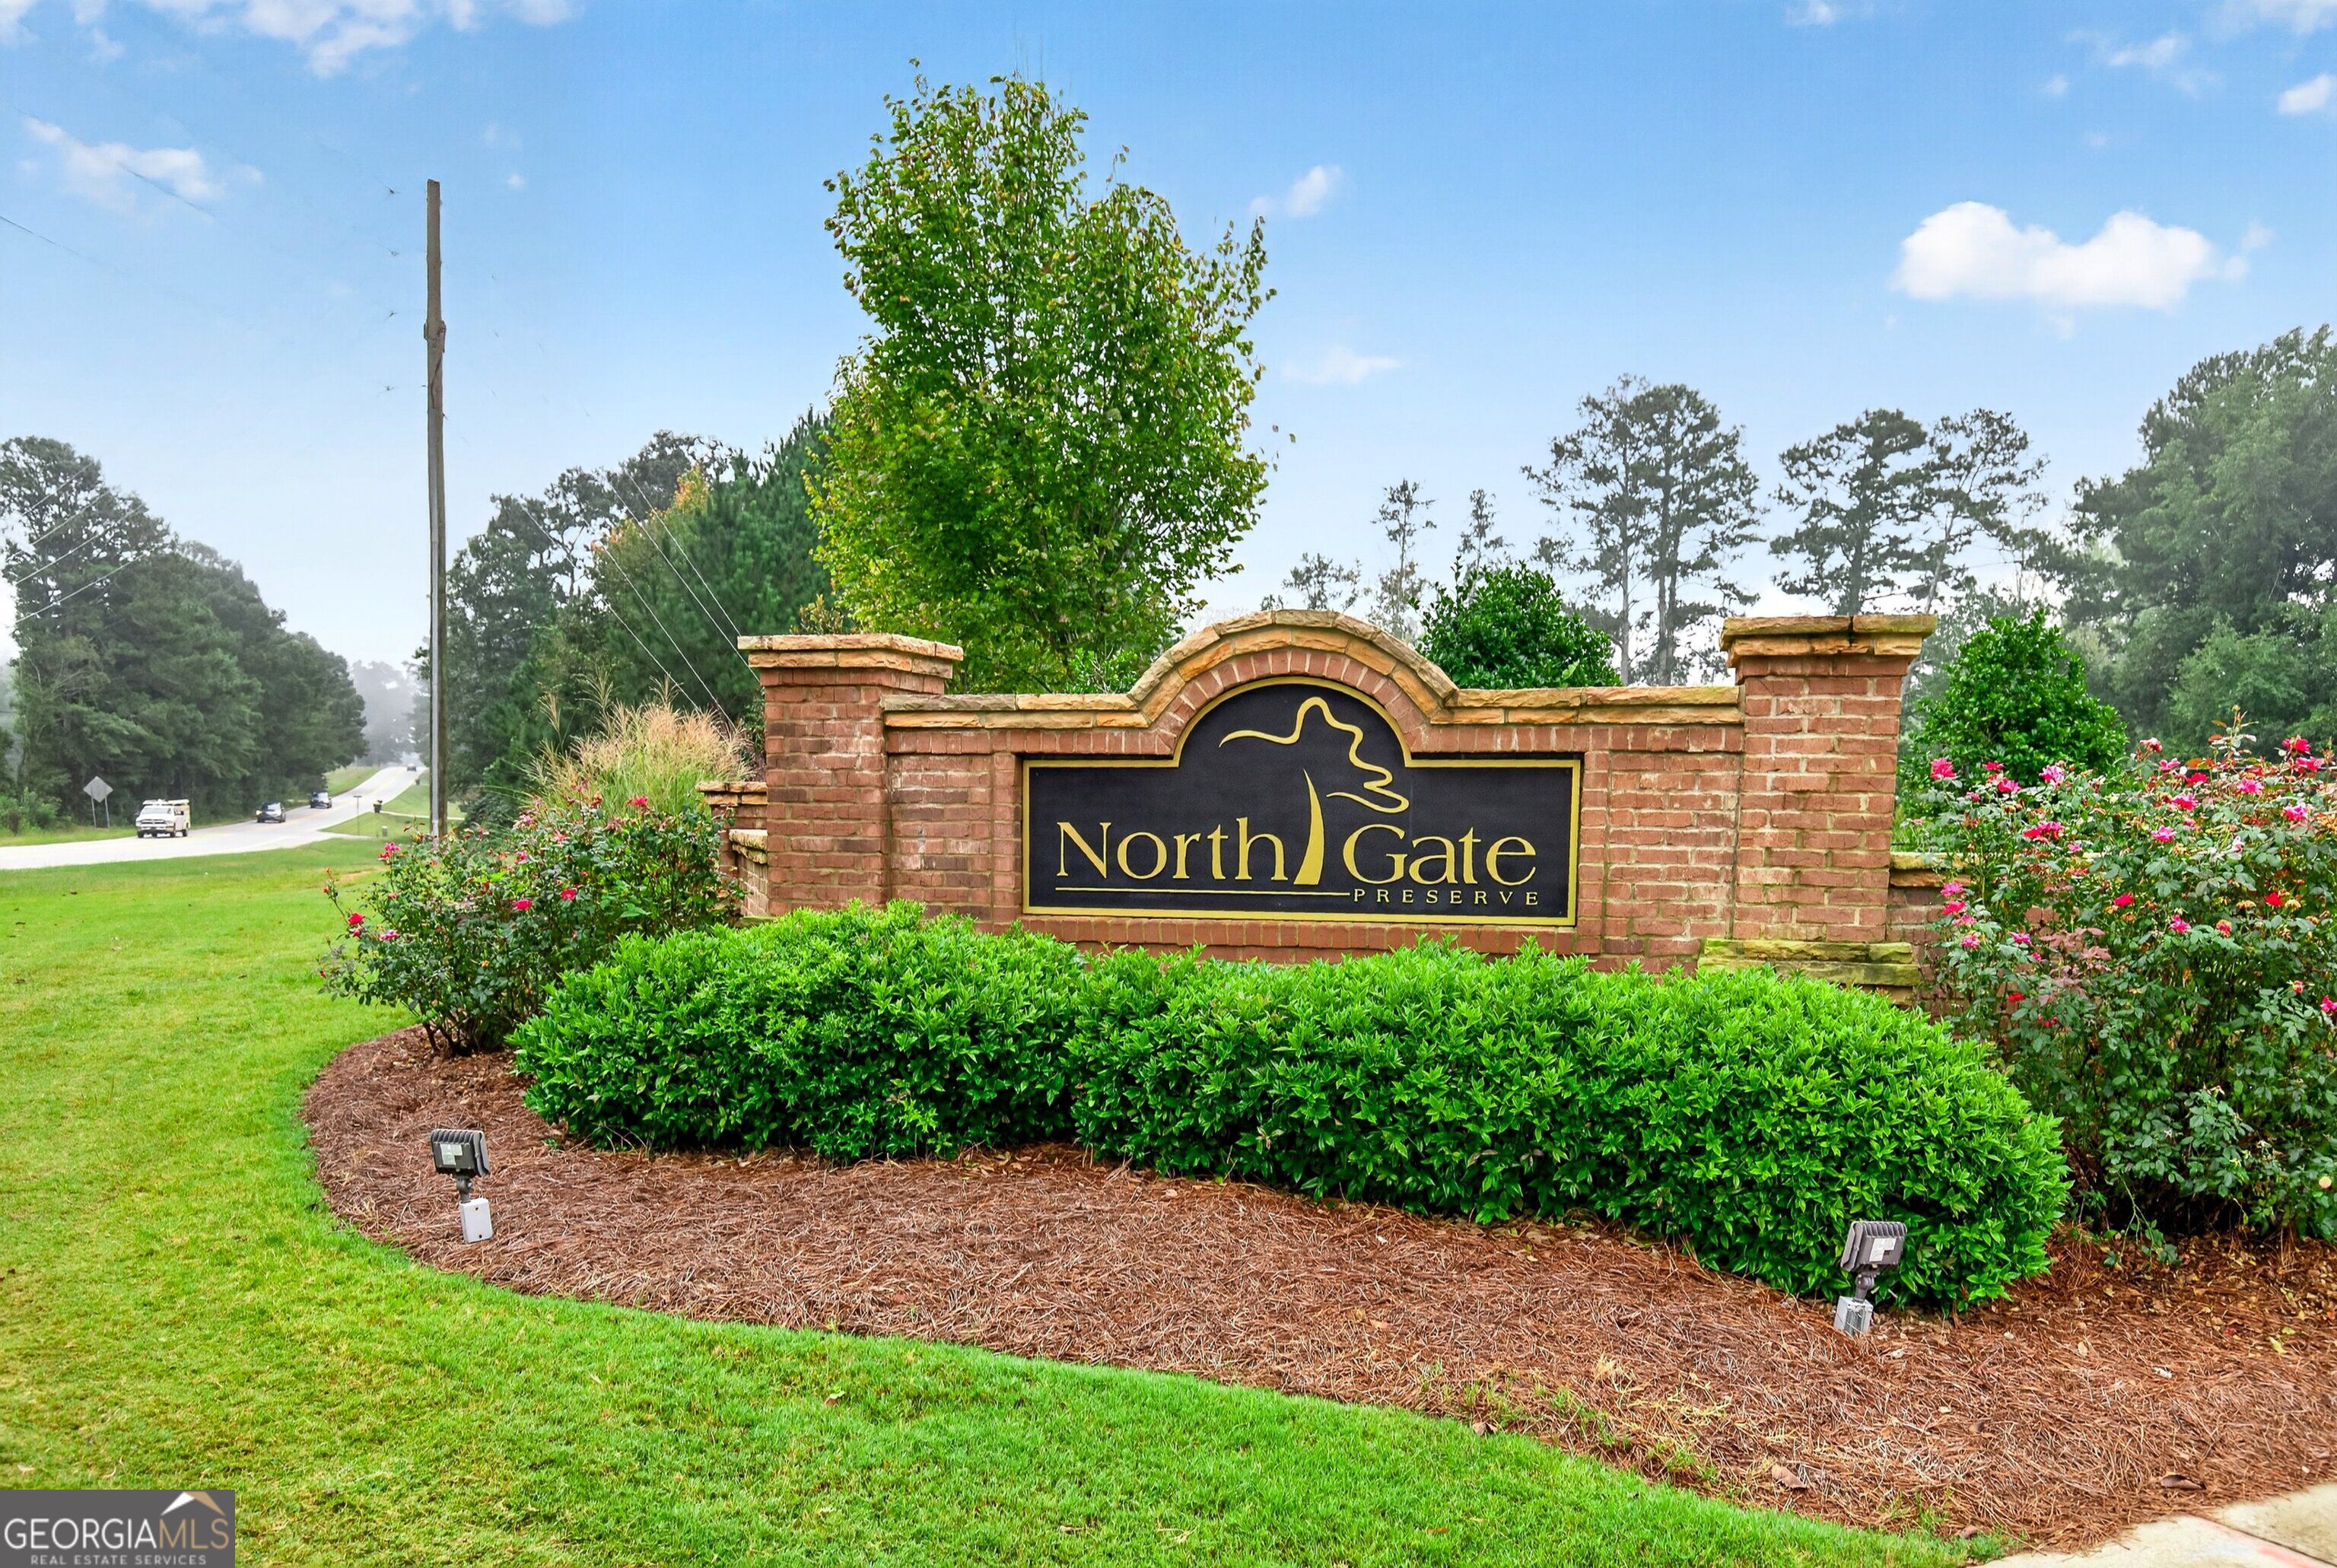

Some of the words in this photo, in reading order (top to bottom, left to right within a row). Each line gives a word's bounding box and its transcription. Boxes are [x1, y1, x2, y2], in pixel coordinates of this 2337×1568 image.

[1056, 816, 1289, 882] North
[1342, 824, 1537, 886] Gate
[1353, 888, 1539, 906] PRESERVE
